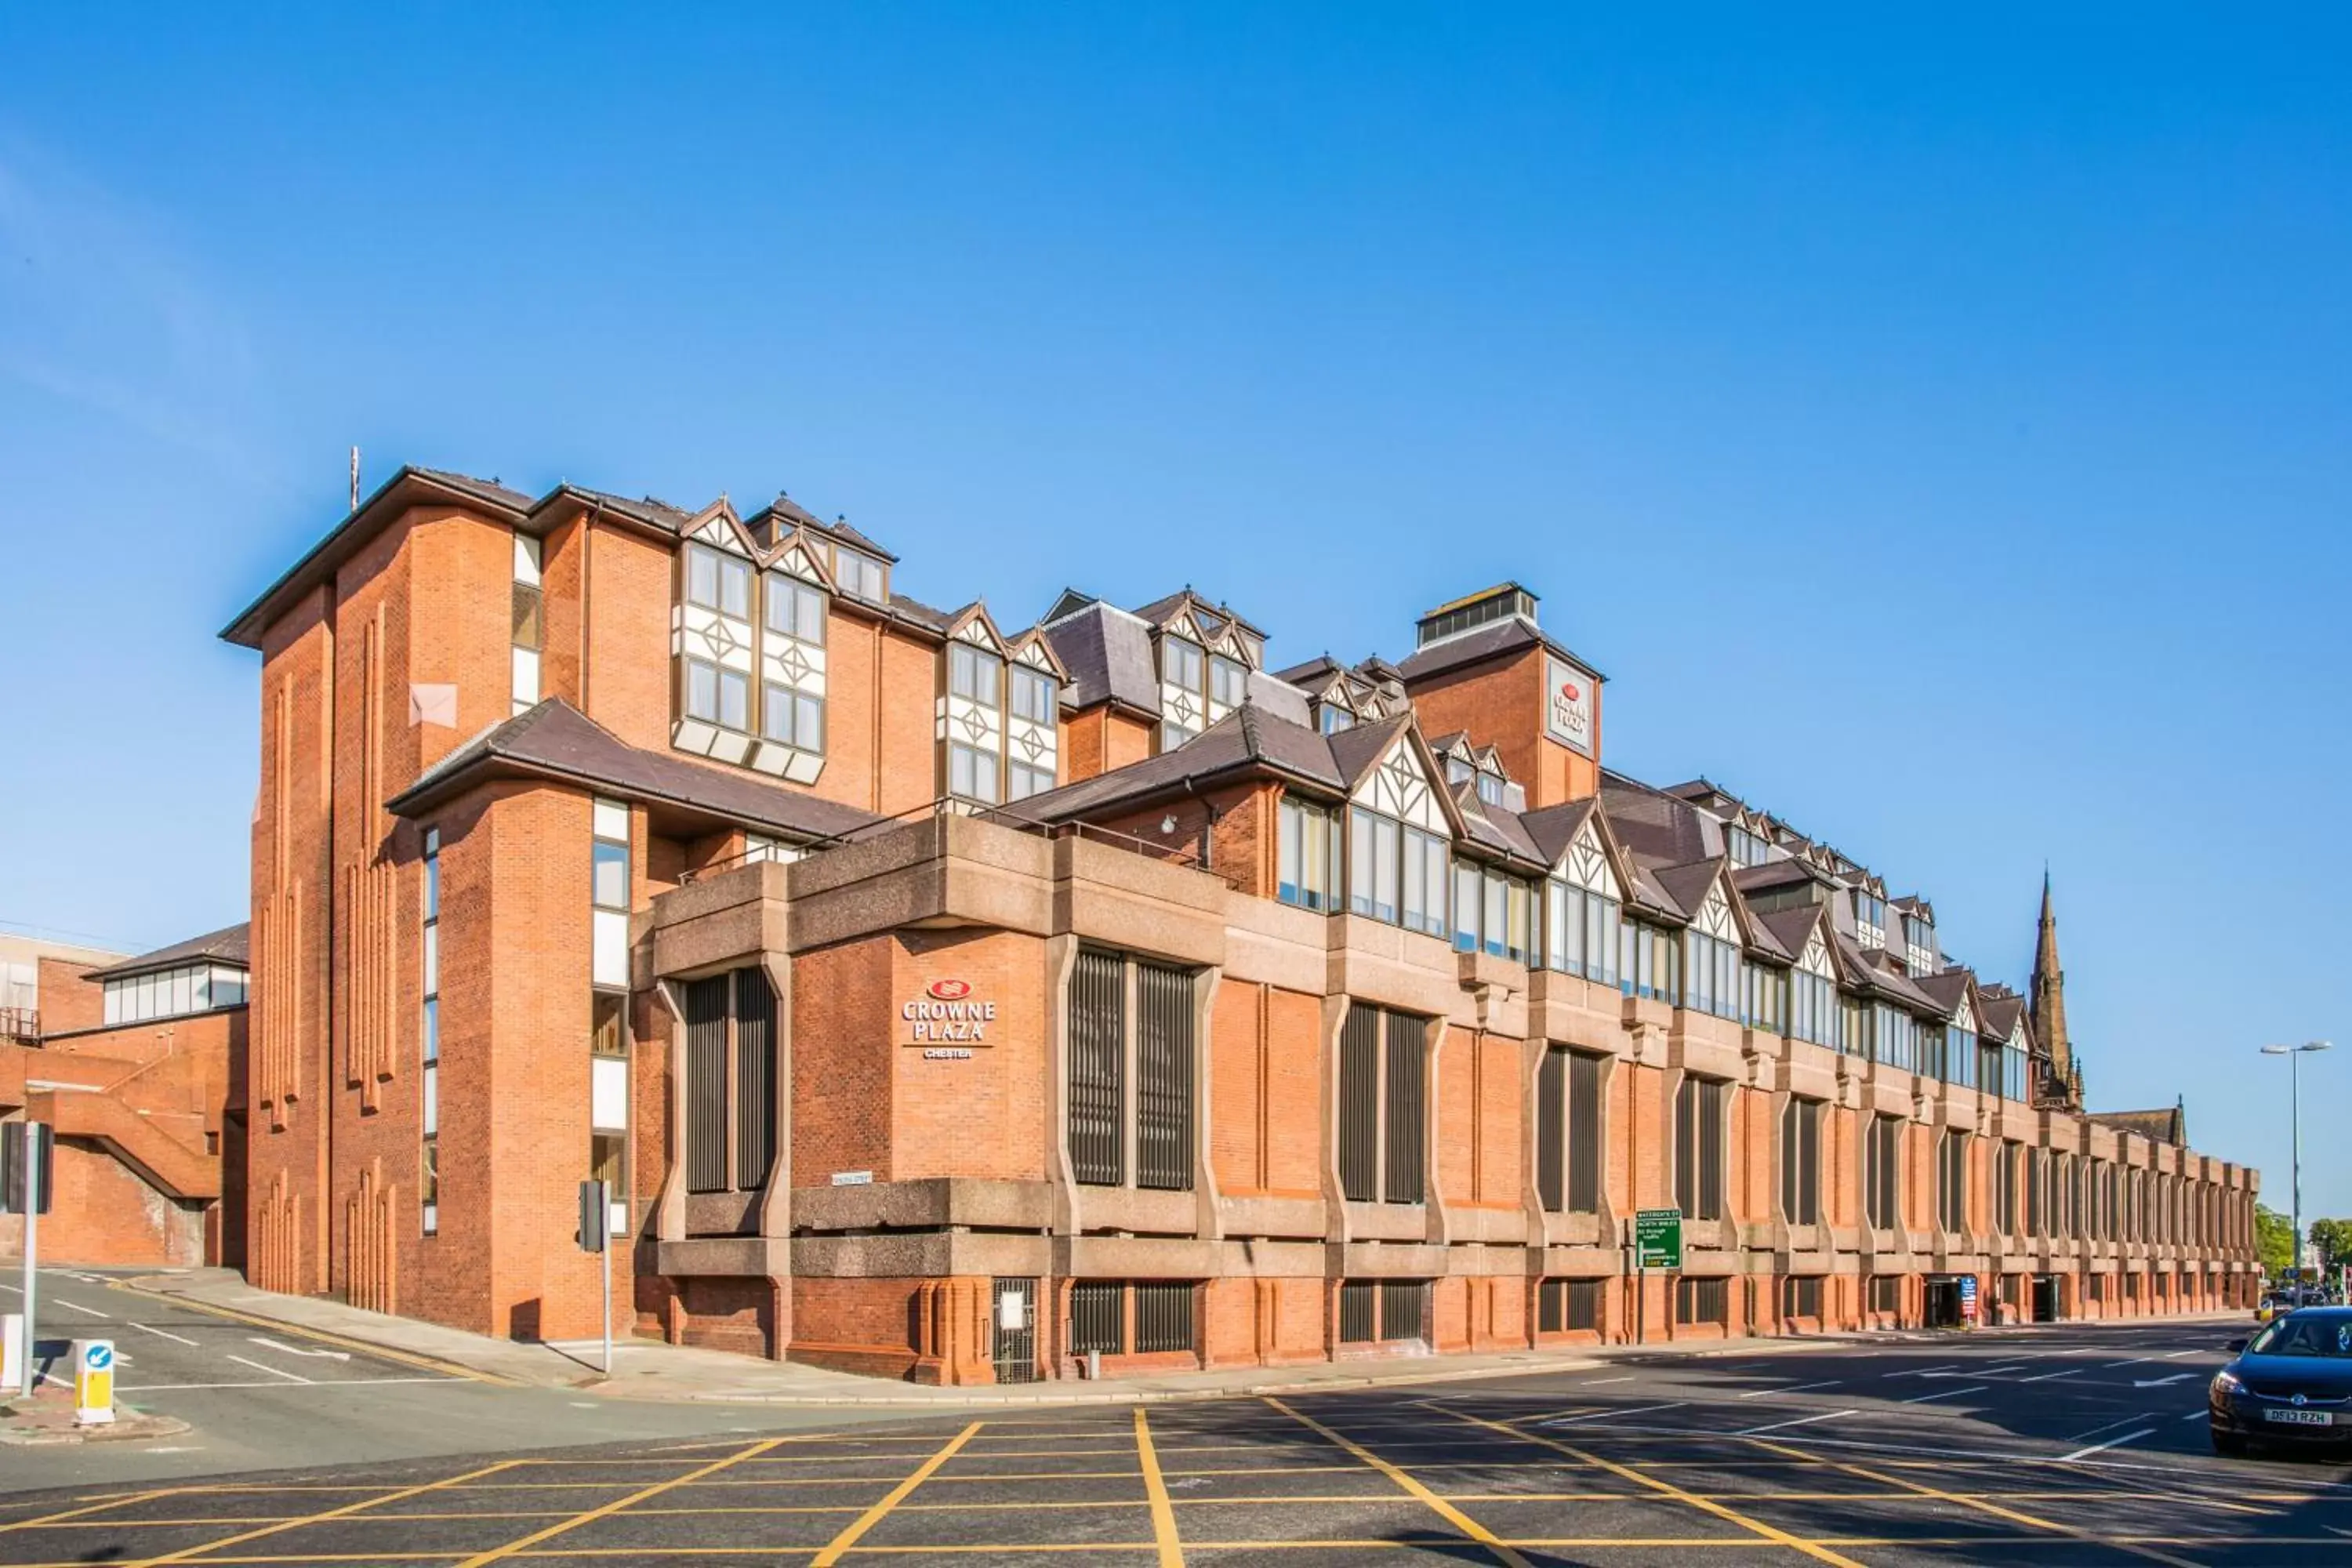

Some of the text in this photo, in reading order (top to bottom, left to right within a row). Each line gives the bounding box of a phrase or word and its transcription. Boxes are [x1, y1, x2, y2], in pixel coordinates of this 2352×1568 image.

[902, 1000, 996, 1021] CROWNE
[913, 1021, 984, 1041] PLAZA
[923, 1048, 972, 1059] CHESTER
